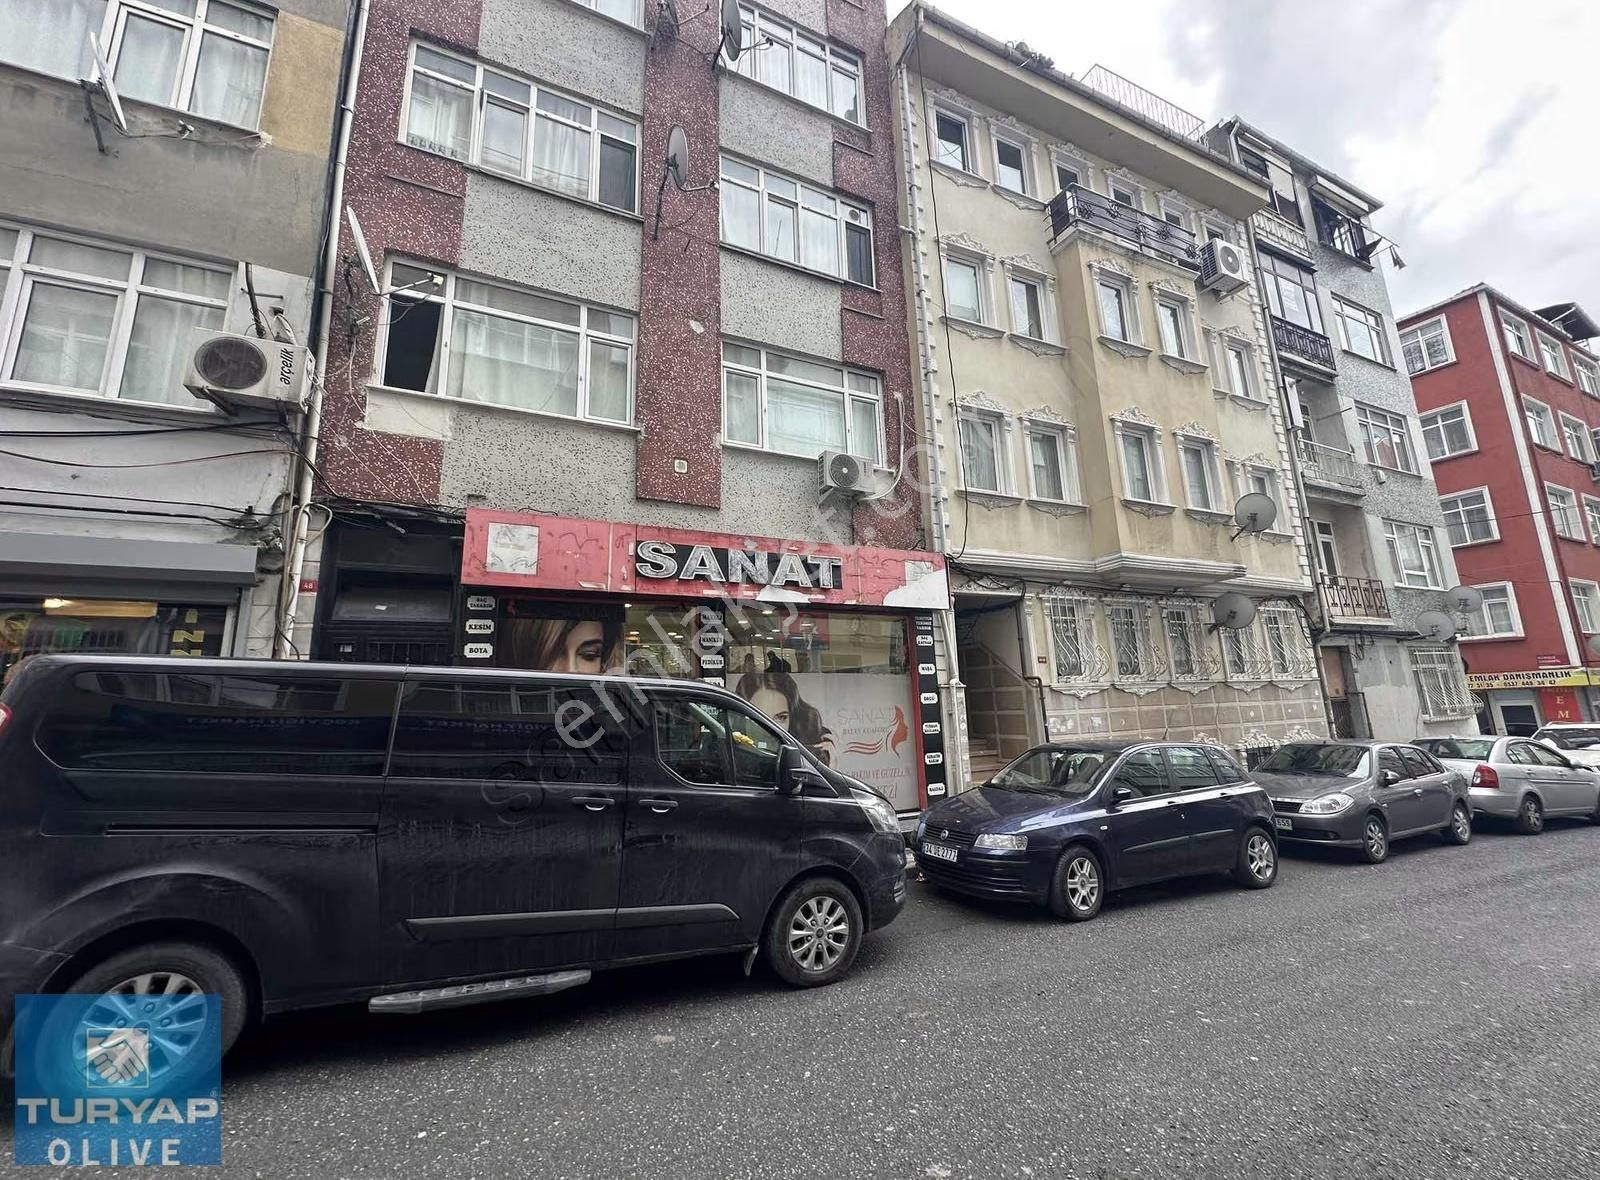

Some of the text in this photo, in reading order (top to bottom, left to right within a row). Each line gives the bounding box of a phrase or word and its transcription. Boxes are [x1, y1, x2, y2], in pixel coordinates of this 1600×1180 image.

[280, 347, 294, 385] arçelik
[636, 540, 842, 589] SANAT
[468, 623, 492, 631] KESİM
[1469, 674, 1500, 682] EMLAK
